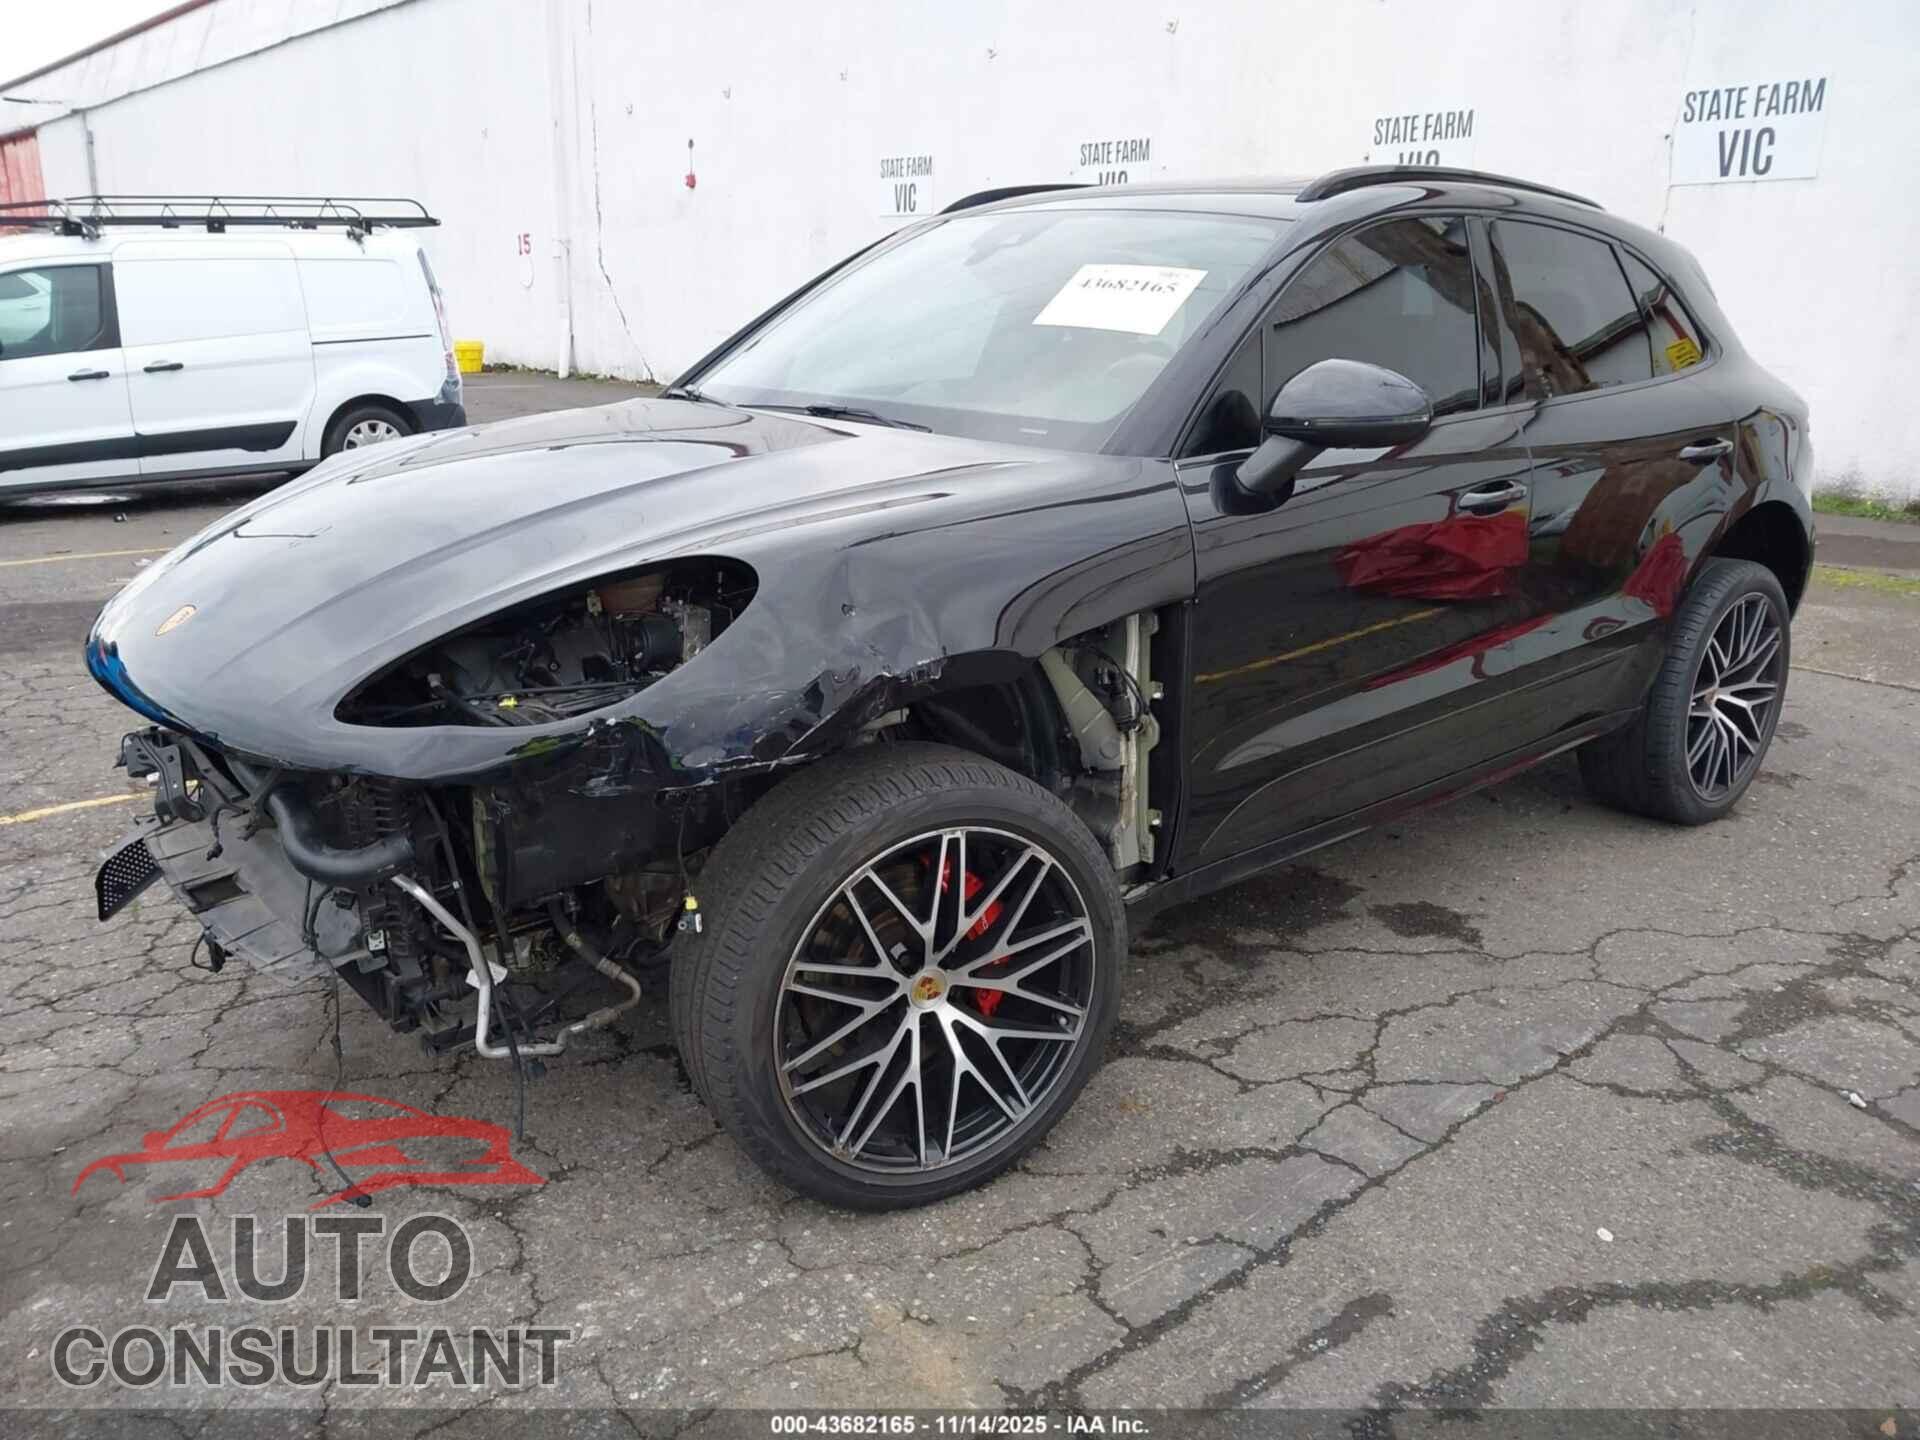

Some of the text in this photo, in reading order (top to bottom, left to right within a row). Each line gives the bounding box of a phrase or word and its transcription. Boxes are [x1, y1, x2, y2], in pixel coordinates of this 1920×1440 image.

[1683, 77, 1826, 123] STATE FARM
[1374, 109, 1474, 146] STATE FARM
[880, 154, 932, 179] STATE FARM
[1080, 138, 1150, 167] STATE FARM
[1718, 126, 1776, 177] VIC
[894, 182, 917, 213] VIC
[517, 233, 532, 256] 15
